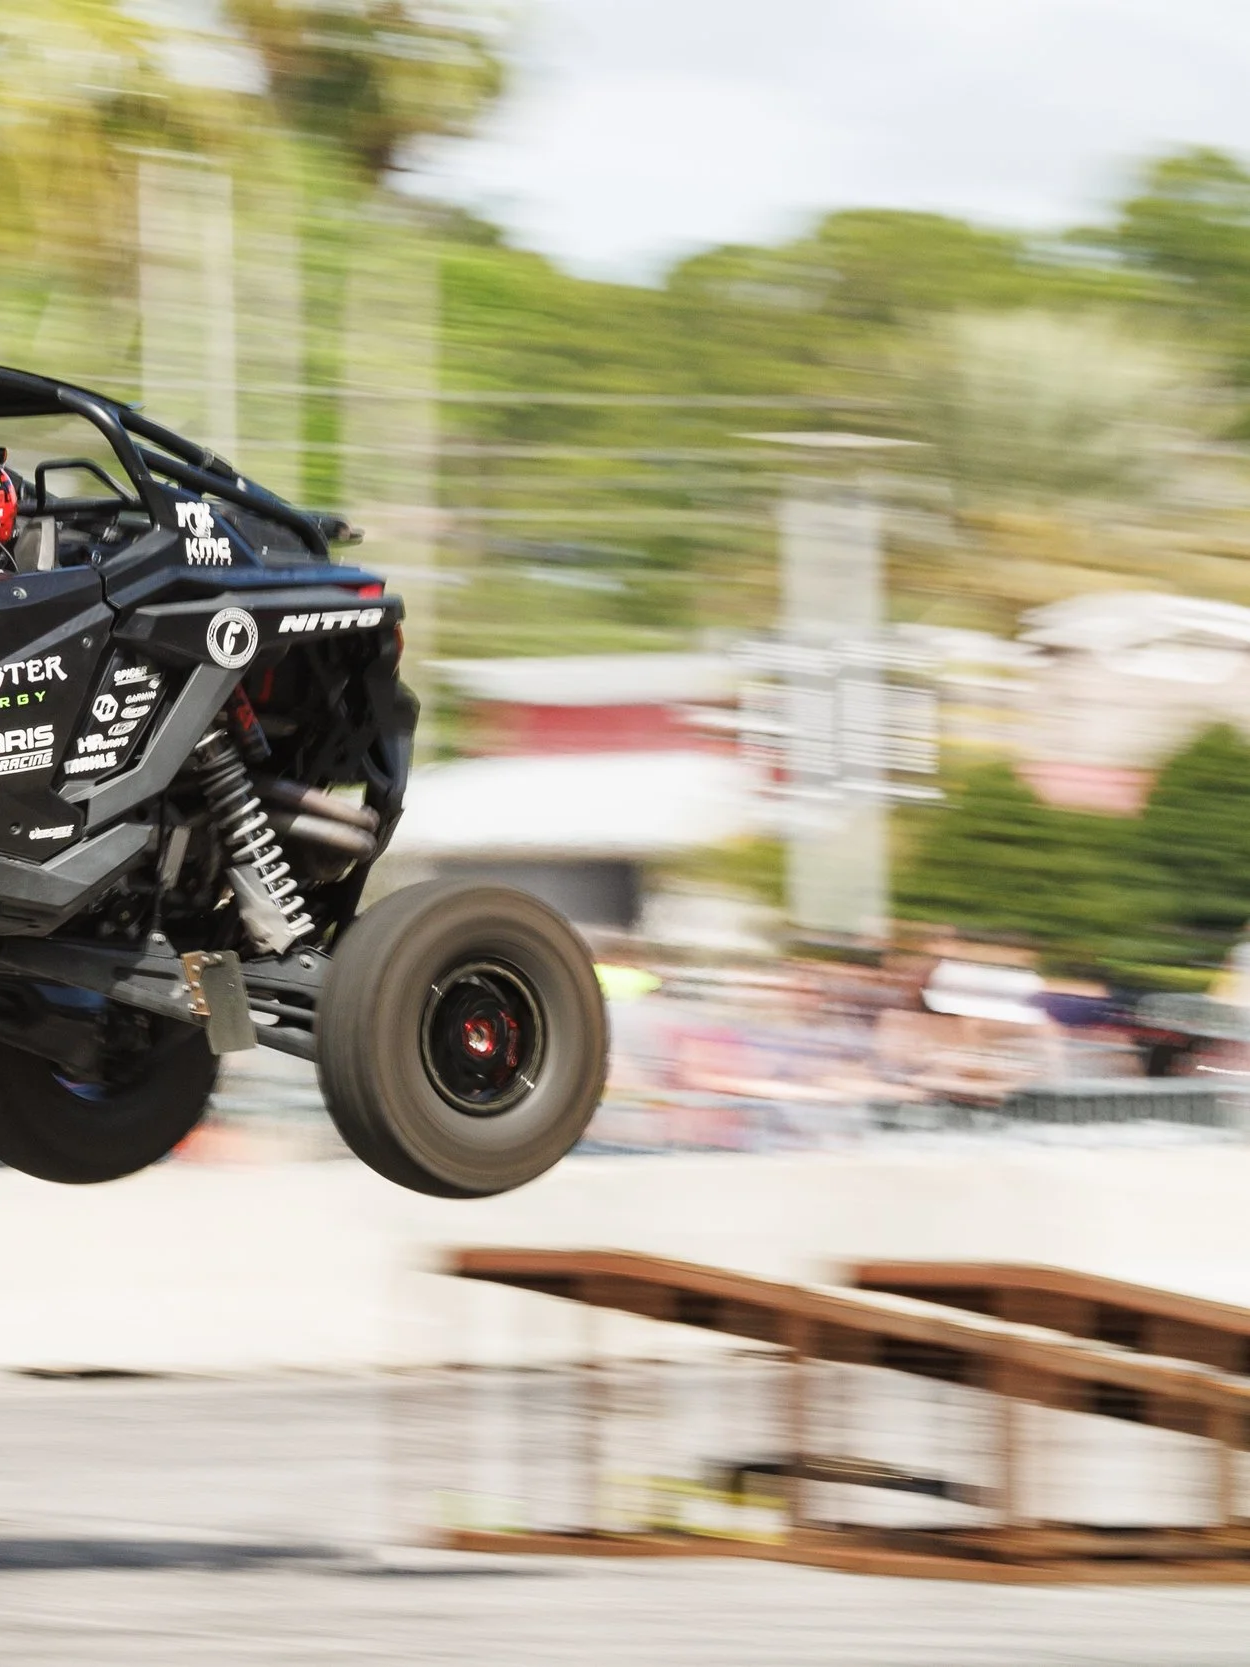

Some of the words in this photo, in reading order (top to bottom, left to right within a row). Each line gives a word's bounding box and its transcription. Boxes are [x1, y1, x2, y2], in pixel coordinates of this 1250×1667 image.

[278, 607, 383, 633] NITTO
[125, 690, 157, 704] GARMIN
[0, 751, 53, 774] RACING
